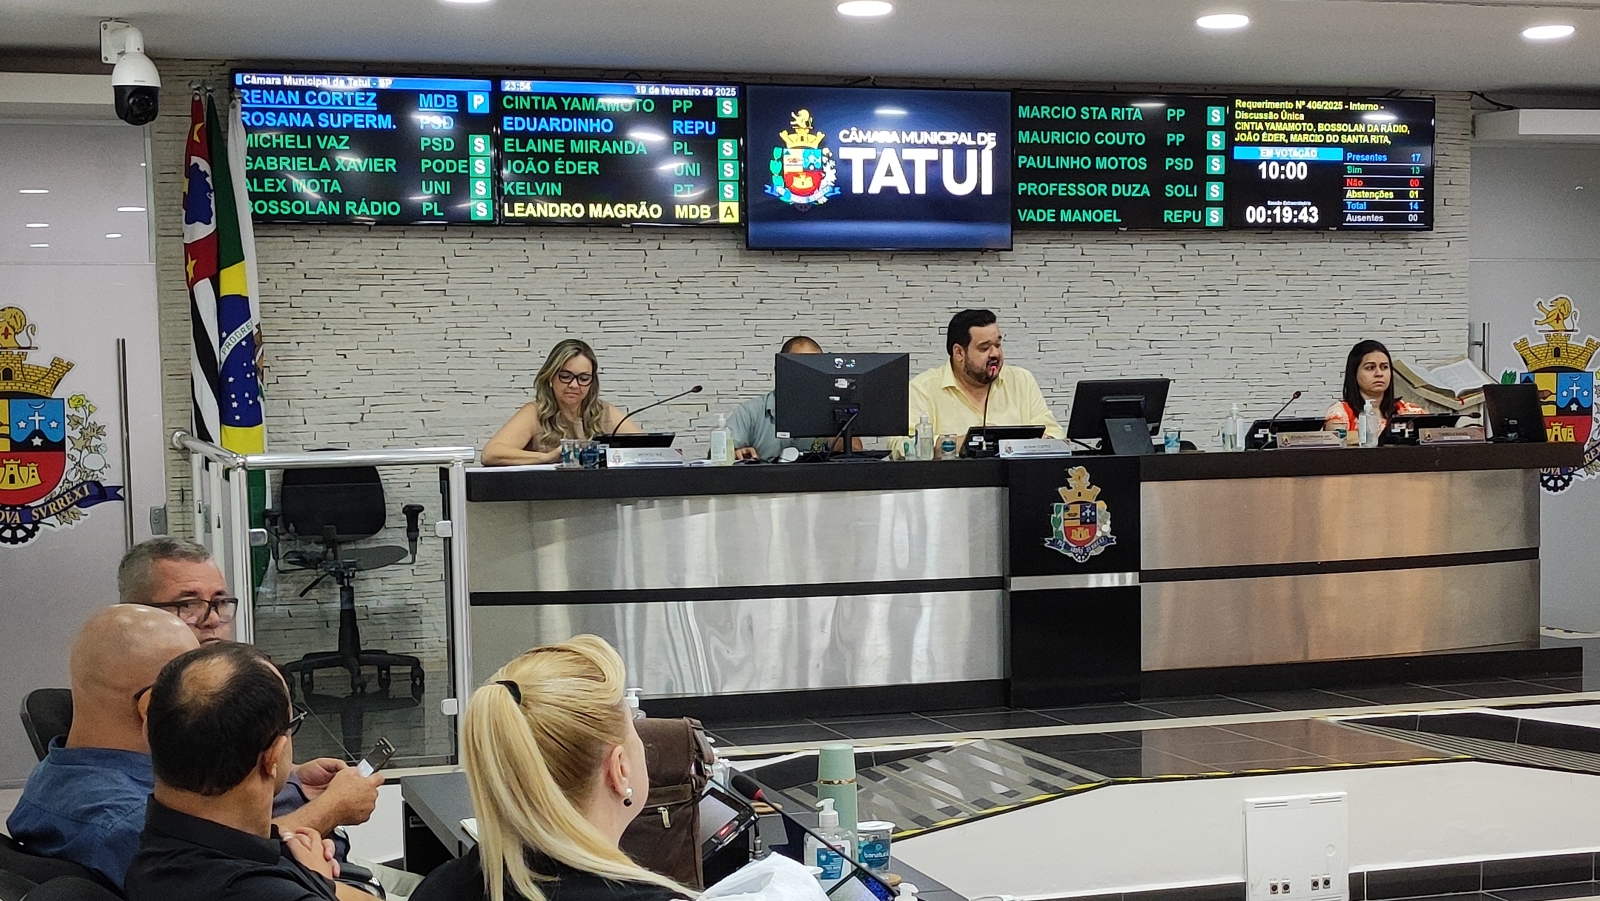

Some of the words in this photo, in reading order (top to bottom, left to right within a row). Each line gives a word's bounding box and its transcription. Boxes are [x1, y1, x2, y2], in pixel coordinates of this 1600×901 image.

[243, 75, 281, 85] Câmara
[284, 76, 330, 88] Municipal
[334, 77, 345, 87] de
[379, 79, 392, 88] SP
[504, 81, 531, 91] 23:54
[636, 86, 646, 94] 19
[648, 86, 659, 95] de
[661, 86, 700, 96] fevereiro
[702, 87, 713, 96] de
[716, 87, 736, 96] 2025
[305, 91, 377, 107] CORTEZ
[419, 93, 458, 109] MDB
[473, 95, 485, 109] P
[502, 96, 557, 111] CINTIA
[561, 97, 655, 113] YAMAMOTO
[673, 99, 693, 113] PP
[722, 101, 732, 115] S
[1235, 99, 1294, 110] Requerimento
[1306, 101, 1343, 110] 406/2025
[1349, 101, 1379, 110] Interno
[318, 113, 397, 129] SUPERM.
[419, 115, 455, 130] PSD
[1018, 105, 1077, 120] MARCIO
[1080, 106, 1108, 120] STA
[1111, 107, 1143, 121] RITA
[1167, 108, 1185, 121] PP
[1211, 109, 1220, 123] S
[1235, 110, 1279, 120] Discussão
[1280, 109, 1305, 121] Única
[502, 116, 614, 133] EDUARDINHO
[673, 120, 716, 135] REPU
[1234, 121, 1264, 131] CINTIA
[1265, 122, 1316, 133] YAMAMOTO,
[1317, 123, 1365, 133] BOSSOLAN
[1367, 124, 1379, 133] DA
[1381, 123, 1410, 135] RÁDIO,
[316, 135, 350, 150] VAZ
[421, 137, 454, 152] PSD
[474, 138, 485, 152] S
[839, 126, 900, 144] CÂMARA
[902, 130, 976, 145] MUNICIPAL
[977, 132, 996, 145] DE
[1018, 130, 1091, 144] MAURICIO
[1094, 132, 1146, 146] COUTO
[1166, 133, 1185, 146] PP
[1211, 133, 1220, 147] S
[1234, 131, 1260, 142] JOÃO
[1261, 131, 1288, 144] ÉDER,
[1290, 133, 1324, 143] MARCIO
[1326, 134, 1339, 143] DO
[1341, 135, 1369, 144] SANTA
[1370, 135, 1391, 145] RITA,
[503, 138, 564, 153] ELAINE
[570, 140, 648, 155] MIRANDA
[673, 141, 693, 156] PL
[722, 142, 733, 156] S
[335, 157, 397, 173] XAVIER
[421, 159, 468, 174] PODE
[474, 159, 486, 174] S
[1018, 155, 1092, 169] PAULINHO
[1095, 156, 1147, 170] MOTOS
[1165, 158, 1193, 171] PSD
[1211, 158, 1221, 171] S
[1346, 152, 1387, 161] Presentes
[1411, 153, 1421, 162] 17
[504, 158, 550, 175] JOÃO
[555, 157, 600, 175] ÉDER
[674, 162, 701, 176] UNI
[723, 163, 733, 177] S
[839, 143, 997, 196] TATUÍ
[1258, 161, 1308, 180] 10:00
[1346, 165, 1362, 174] Sim
[1410, 166, 1420, 174] 13
[292, 178, 342, 193] MOTA
[422, 181, 450, 195] UNI
[475, 181, 486, 195] S
[504, 181, 562, 196] KELVIN
[673, 184, 693, 198] PT
[723, 184, 733, 198] S
[1018, 183, 1107, 196] PROFESSOR
[1112, 184, 1150, 197] DUZA
[1165, 184, 1197, 197] SOLI
[1210, 184, 1219, 198] S
[1346, 178, 1363, 187] Não
[1409, 178, 1420, 187] 00
[1346, 189, 1394, 200] Abstenções
[1409, 190, 1419, 199] 01
[345, 198, 401, 217] RÁDIO
[423, 202, 444, 216] PL
[476, 203, 487, 217] S
[504, 202, 585, 218] LEANDRO
[589, 201, 662, 219] MAGRÃO
[675, 204, 711, 219] MDB
[724, 206, 734, 218] A
[1346, 201, 1367, 210] Total
[1409, 201, 1419, 210] 14
[1017, 209, 1056, 222] VADE
[1060, 209, 1122, 222] MANOEL
[1163, 210, 1201, 223] REPU
[1210, 210, 1219, 223] S
[1246, 206, 1319, 223] 00:19:43
[1346, 213, 1384, 222] Ausentes
[1408, 213, 1418, 222] 00
[31, 484, 91, 521] SVRREXI
